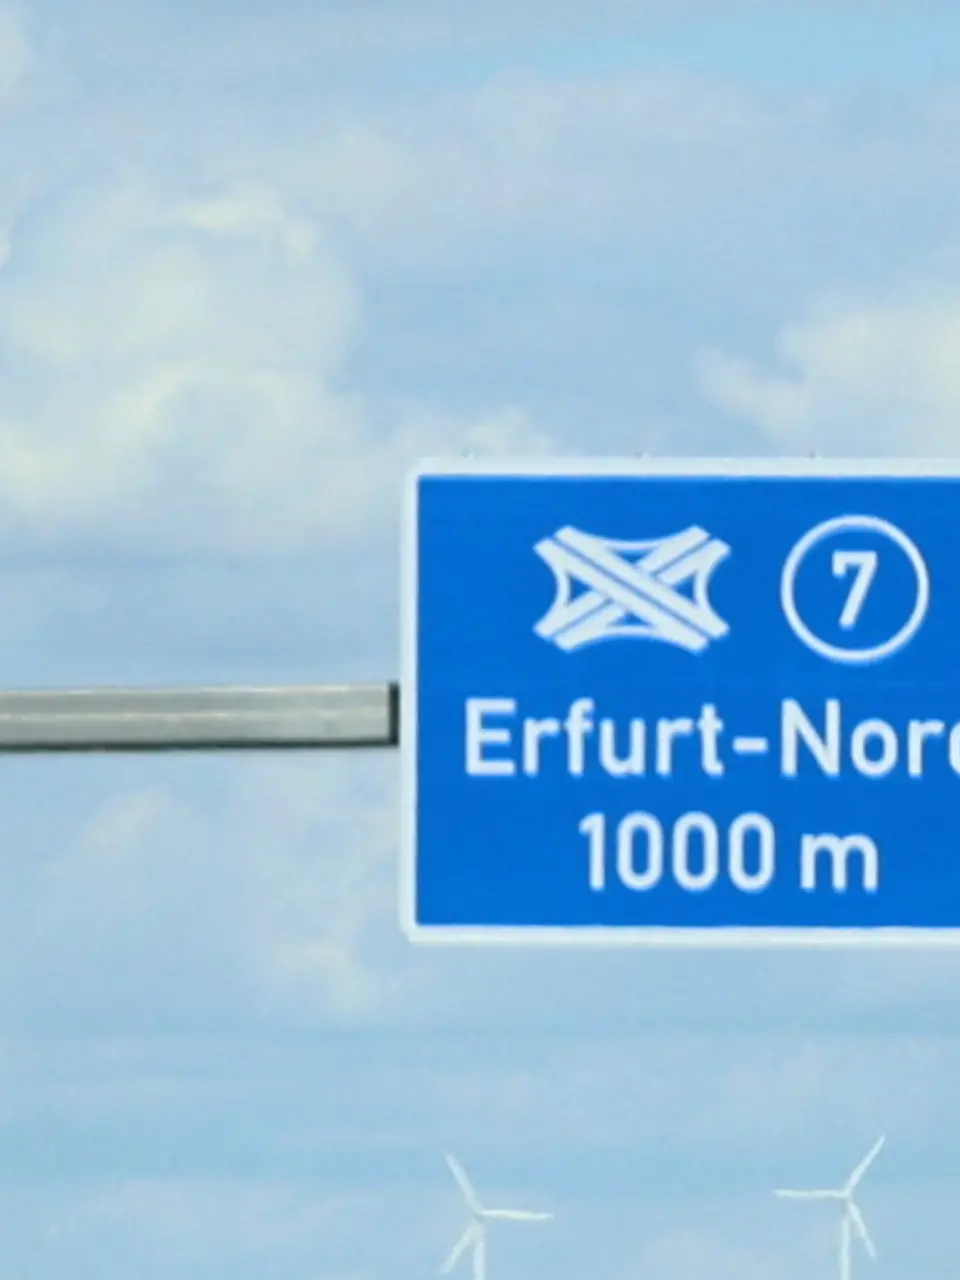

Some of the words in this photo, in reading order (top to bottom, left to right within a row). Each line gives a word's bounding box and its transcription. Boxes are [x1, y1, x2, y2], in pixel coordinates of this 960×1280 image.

[832, 550, 878, 631] 7
[579, 811, 776, 892] 1000
[801, 833, 879, 892] m
